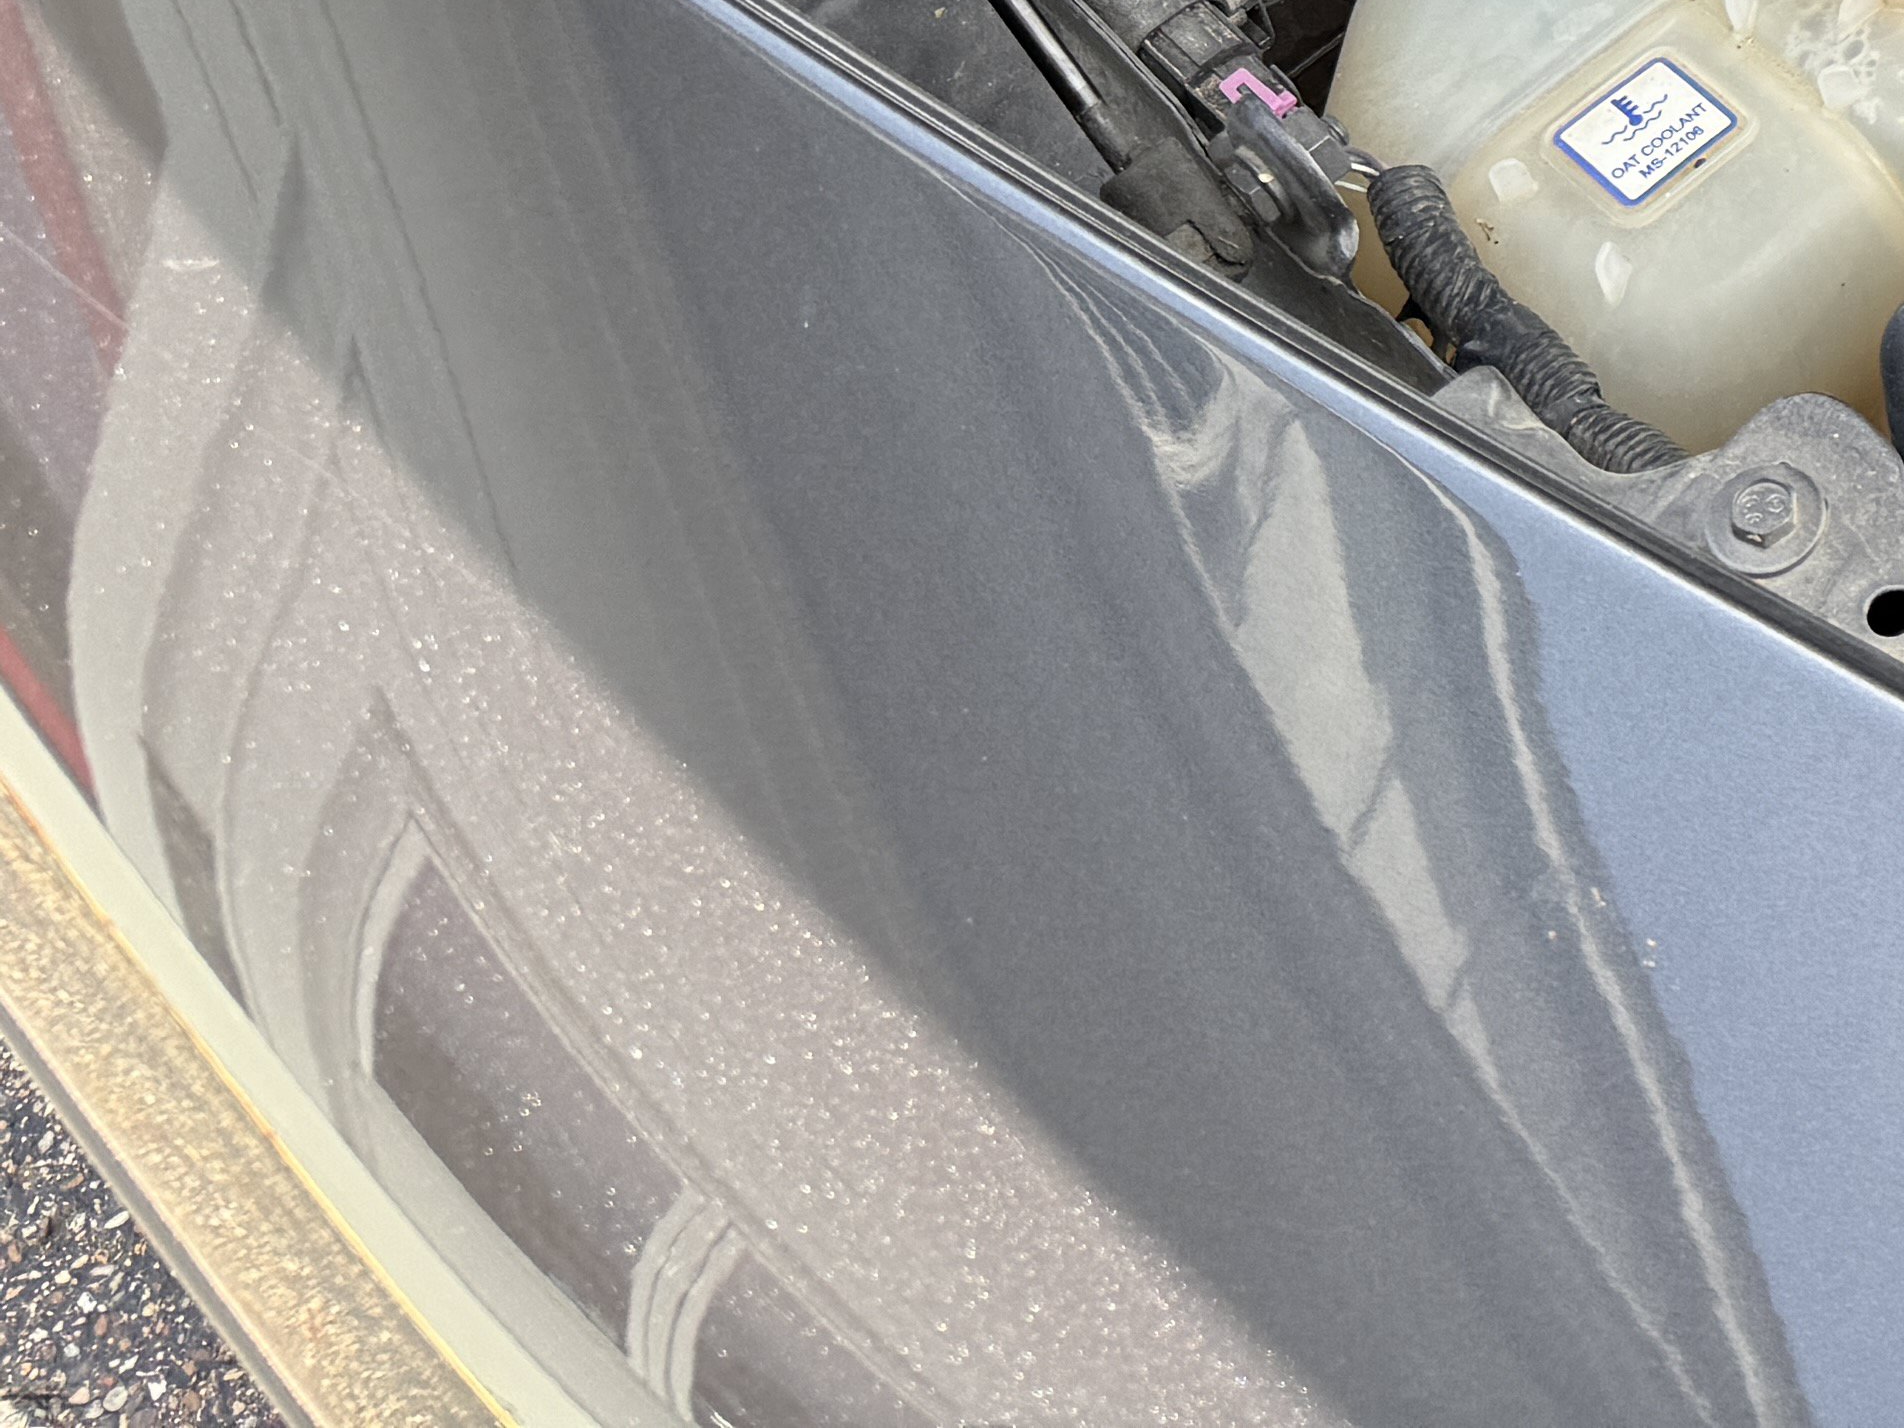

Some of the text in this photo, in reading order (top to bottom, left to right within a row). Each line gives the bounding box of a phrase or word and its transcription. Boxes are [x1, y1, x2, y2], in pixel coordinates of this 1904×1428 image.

[1611, 102, 1707, 179] OAT COOLANT
[1638, 126, 1704, 179] MS-12108
